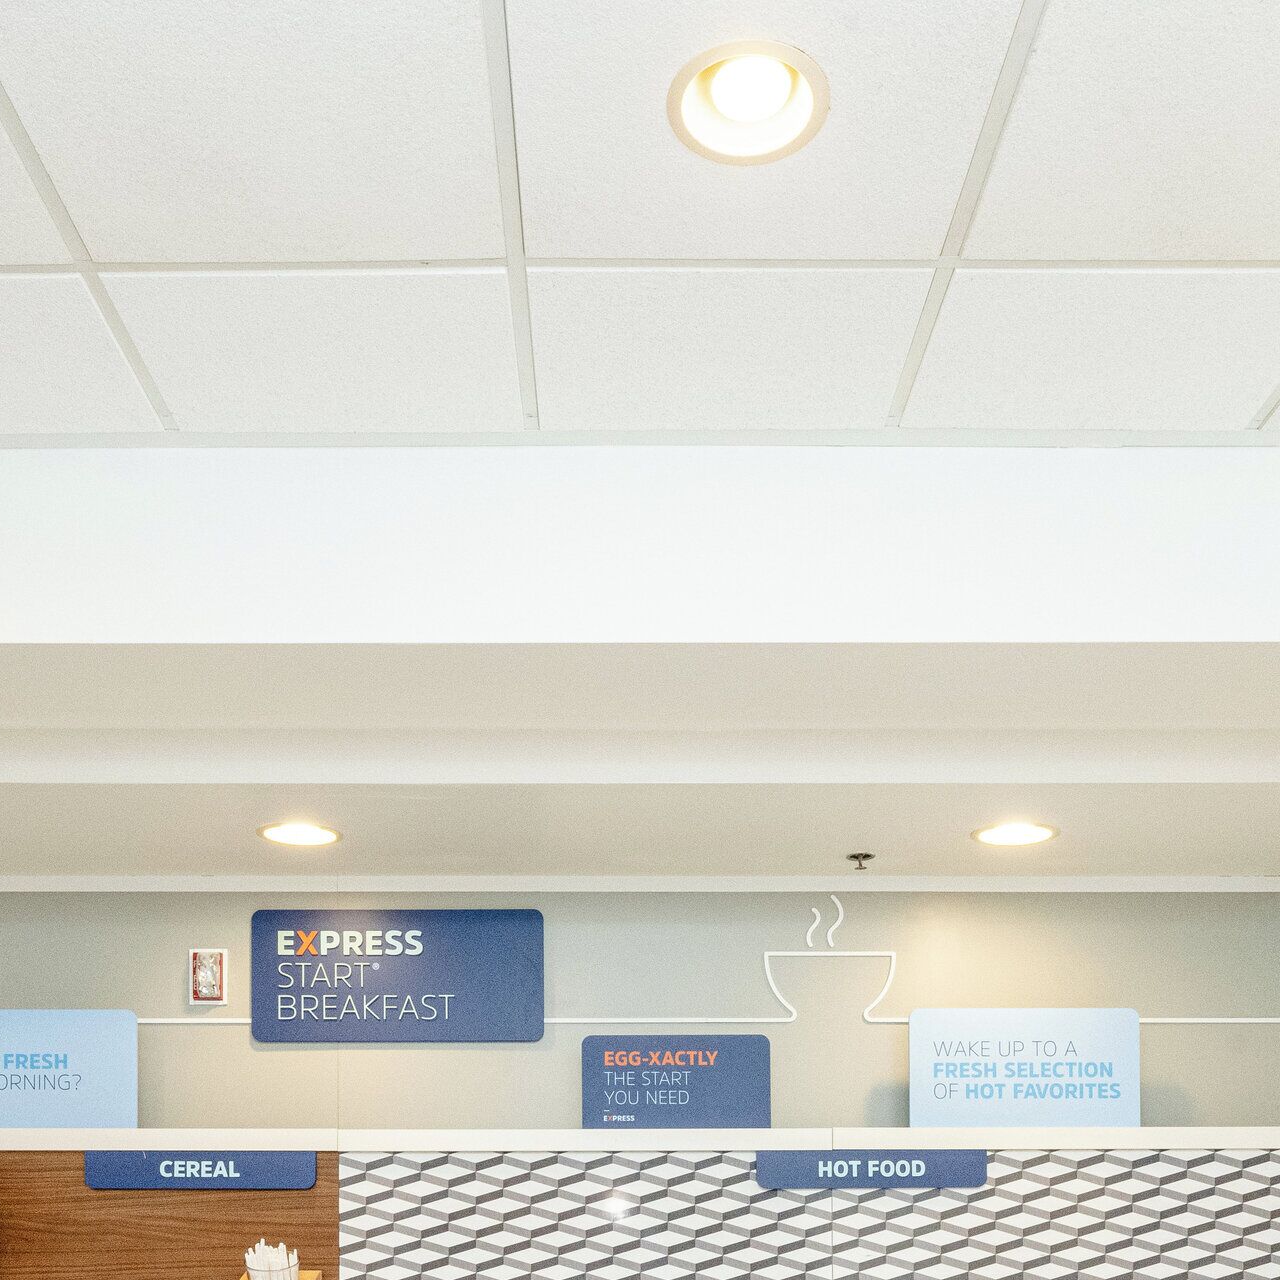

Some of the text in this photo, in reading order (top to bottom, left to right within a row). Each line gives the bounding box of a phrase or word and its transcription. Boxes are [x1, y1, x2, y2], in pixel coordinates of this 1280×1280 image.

[277, 930, 424, 957] EXPRESS
[277, 994, 456, 1020] BREAKFAST
[933, 1040, 1078, 1057] WAKE UP TO A
[3, 1053, 68, 1070] FRESH
[604, 1050, 718, 1066] EGG-XACTLY
[604, 1071, 691, 1085] THE START
[933, 1062, 1113, 1078] FRESH SELECTION
[604, 1090, 690, 1105] YOU NEED
[933, 1083, 1121, 1100] OF HOT FAVORITES
[159, 1160, 240, 1178] CEREAL
[818, 1160, 926, 1178] HOT FOOD
